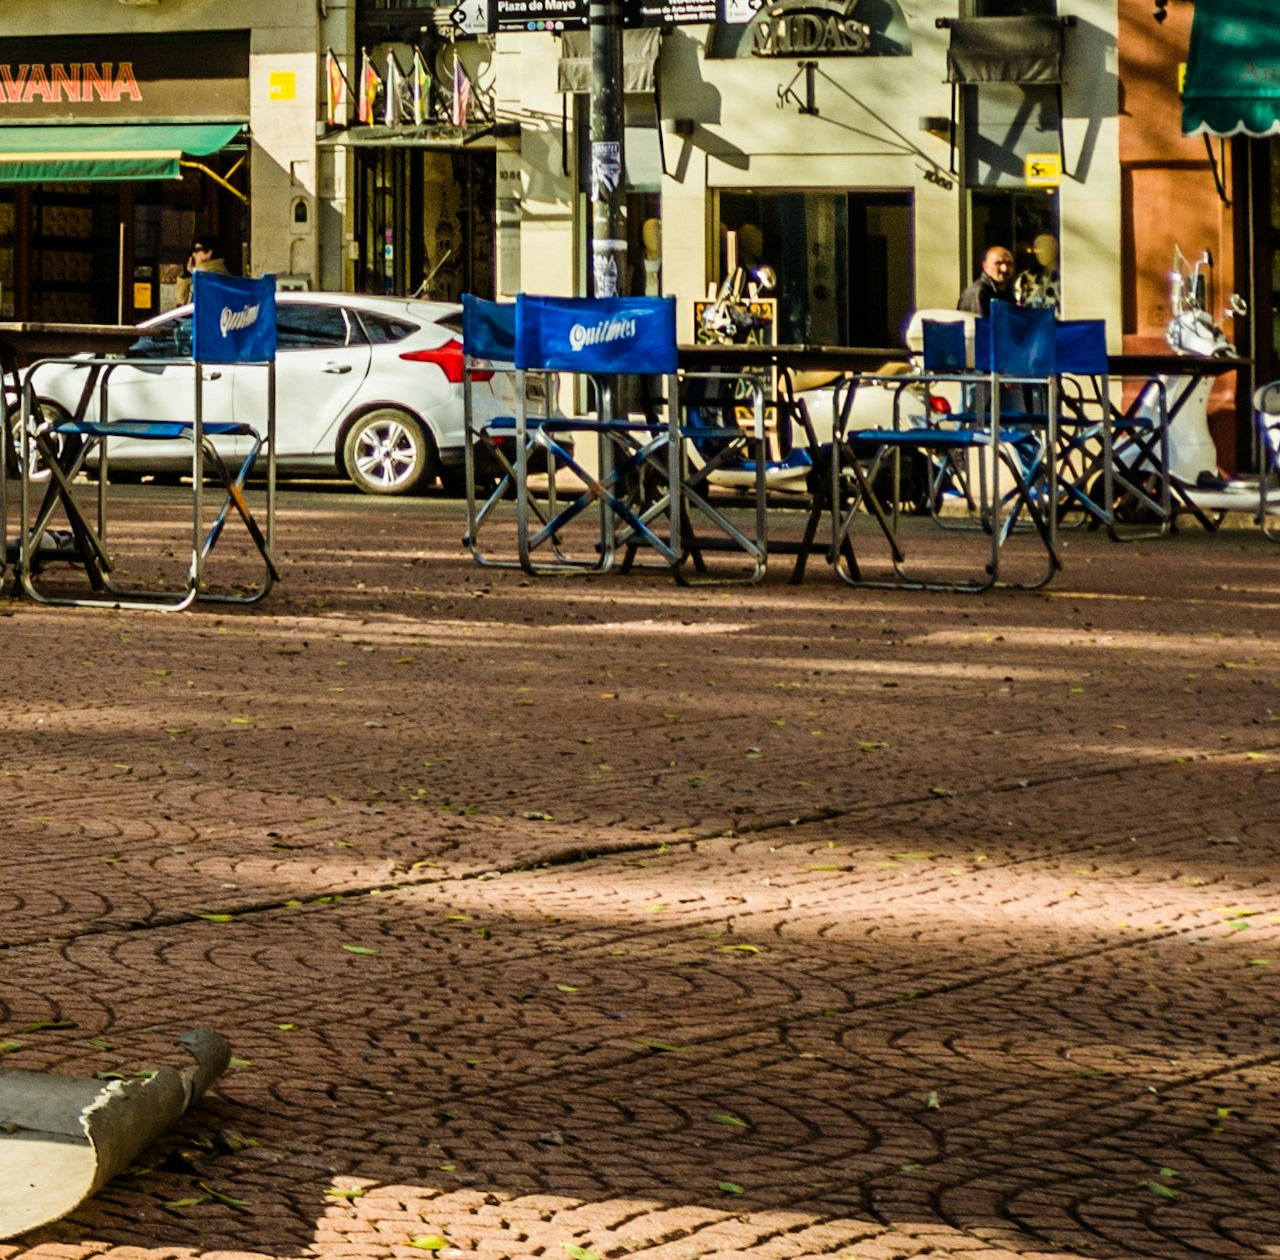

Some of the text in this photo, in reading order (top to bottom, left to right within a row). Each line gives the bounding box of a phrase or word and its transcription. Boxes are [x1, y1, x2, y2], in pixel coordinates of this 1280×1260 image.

[498, 0, 527, 12] Plaza
[529, 0, 543, 11] de
[752, 15, 864, 53] MIDAS
[569, 317, 636, 352] Quilmes
